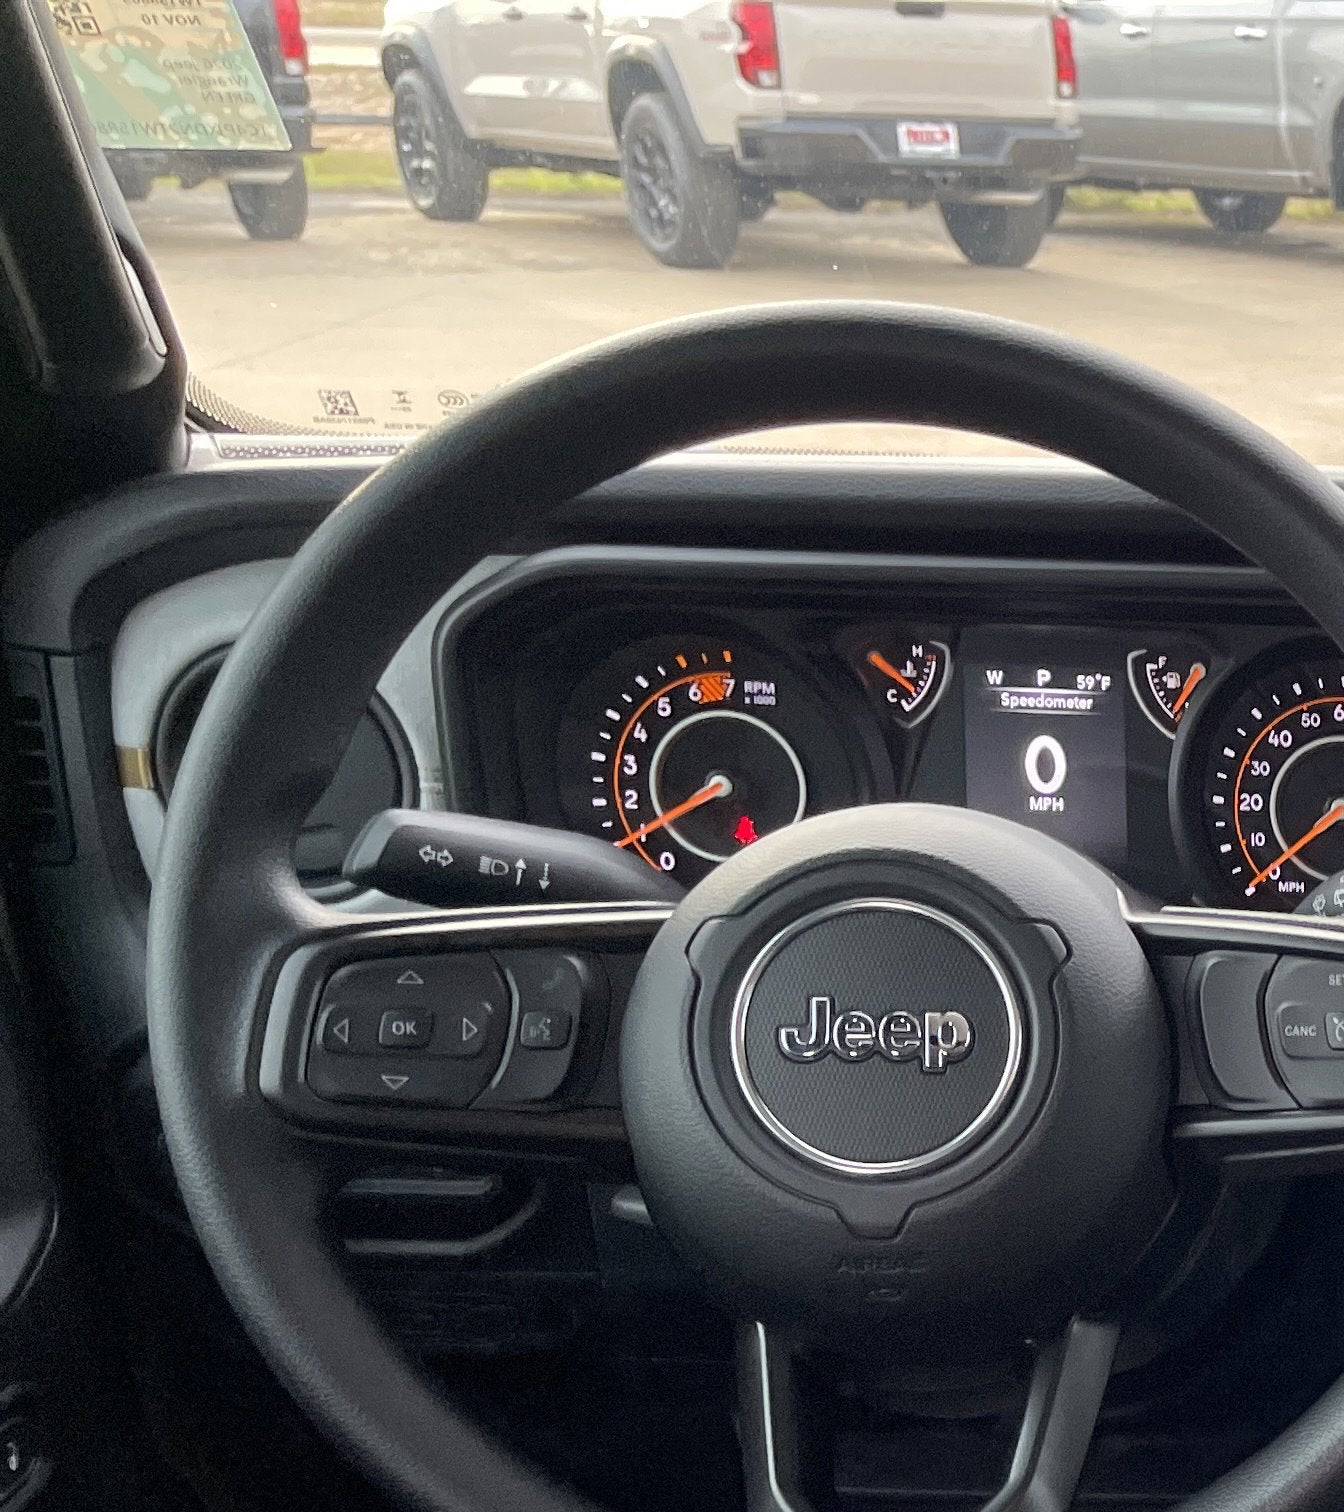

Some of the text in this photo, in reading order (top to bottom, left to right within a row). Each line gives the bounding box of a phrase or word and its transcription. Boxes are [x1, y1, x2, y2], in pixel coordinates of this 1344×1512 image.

[986, 670, 1003, 686] W
[1036, 669, 1051, 686] P
[688, 682, 702, 701] 6
[743, 680, 776, 695] RPM
[886, 688, 898, 704] C
[657, 698, 672, 717] 5
[1000, 692, 1093, 711] Speedometer
[1301, 712, 1320, 729] 50
[633, 722, 648, 743] 4
[1267, 730, 1293, 748] 40
[623, 755, 638, 776] 3
[1023, 734, 1067, 795] 0
[1250, 760, 1271, 777] 30
[624, 790, 639, 810] 2
[1028, 796, 1065, 812] MPH
[1239, 794, 1263, 811] 20
[1250, 831, 1266, 848] 10
[660, 851, 676, 871] 0
[1278, 880, 1305, 894] MPH
[391, 1019, 417, 1036] OK
[778, 995, 974, 1073] Jeep
[1284, 1024, 1317, 1038] CANC
